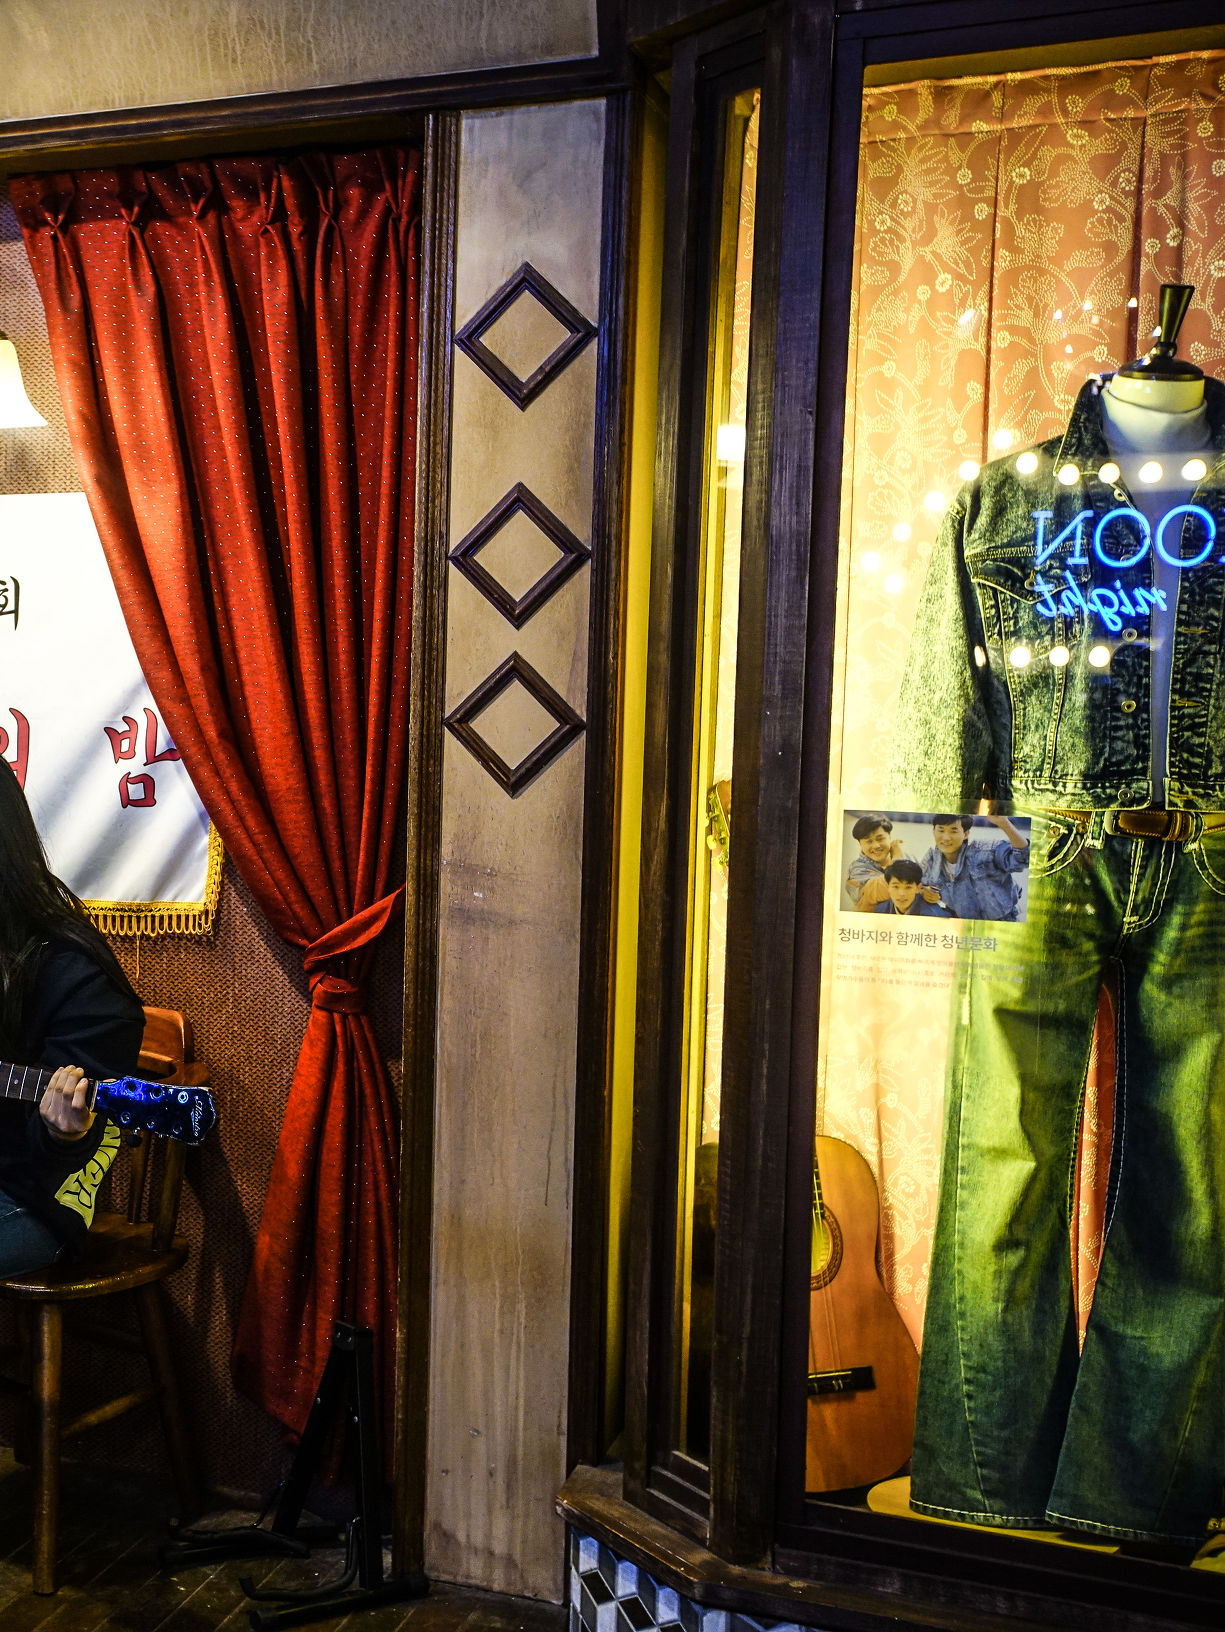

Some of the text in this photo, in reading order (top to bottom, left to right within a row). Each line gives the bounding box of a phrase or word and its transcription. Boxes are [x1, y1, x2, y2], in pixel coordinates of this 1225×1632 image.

[104, 708, 180, 809] 밤
[838, 927, 998, 952] 청바지와 함께한 청년문화
